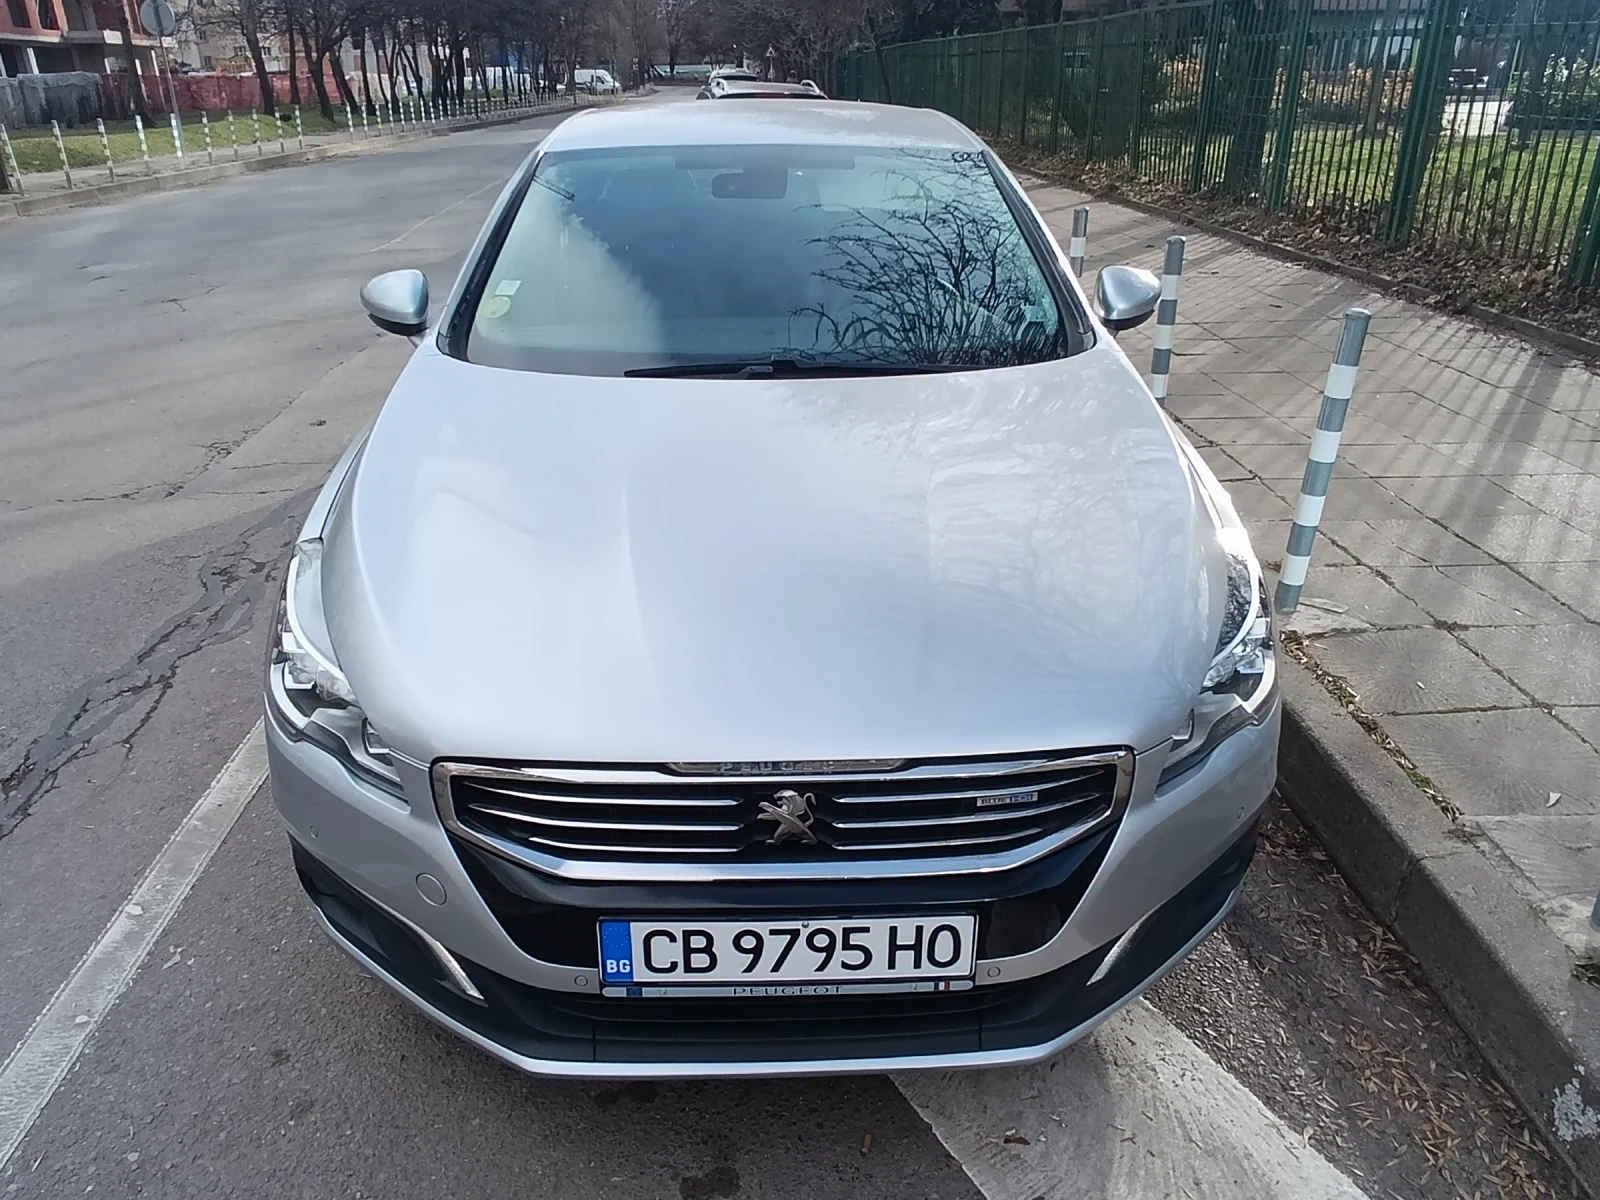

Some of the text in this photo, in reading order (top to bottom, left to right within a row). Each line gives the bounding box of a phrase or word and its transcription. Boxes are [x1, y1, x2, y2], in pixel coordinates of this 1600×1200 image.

[641, 928, 718, 975] CB
[731, 926, 874, 974] 9795
[605, 959, 631, 977] BG
[733, 985, 844, 996] PEUGEOT
